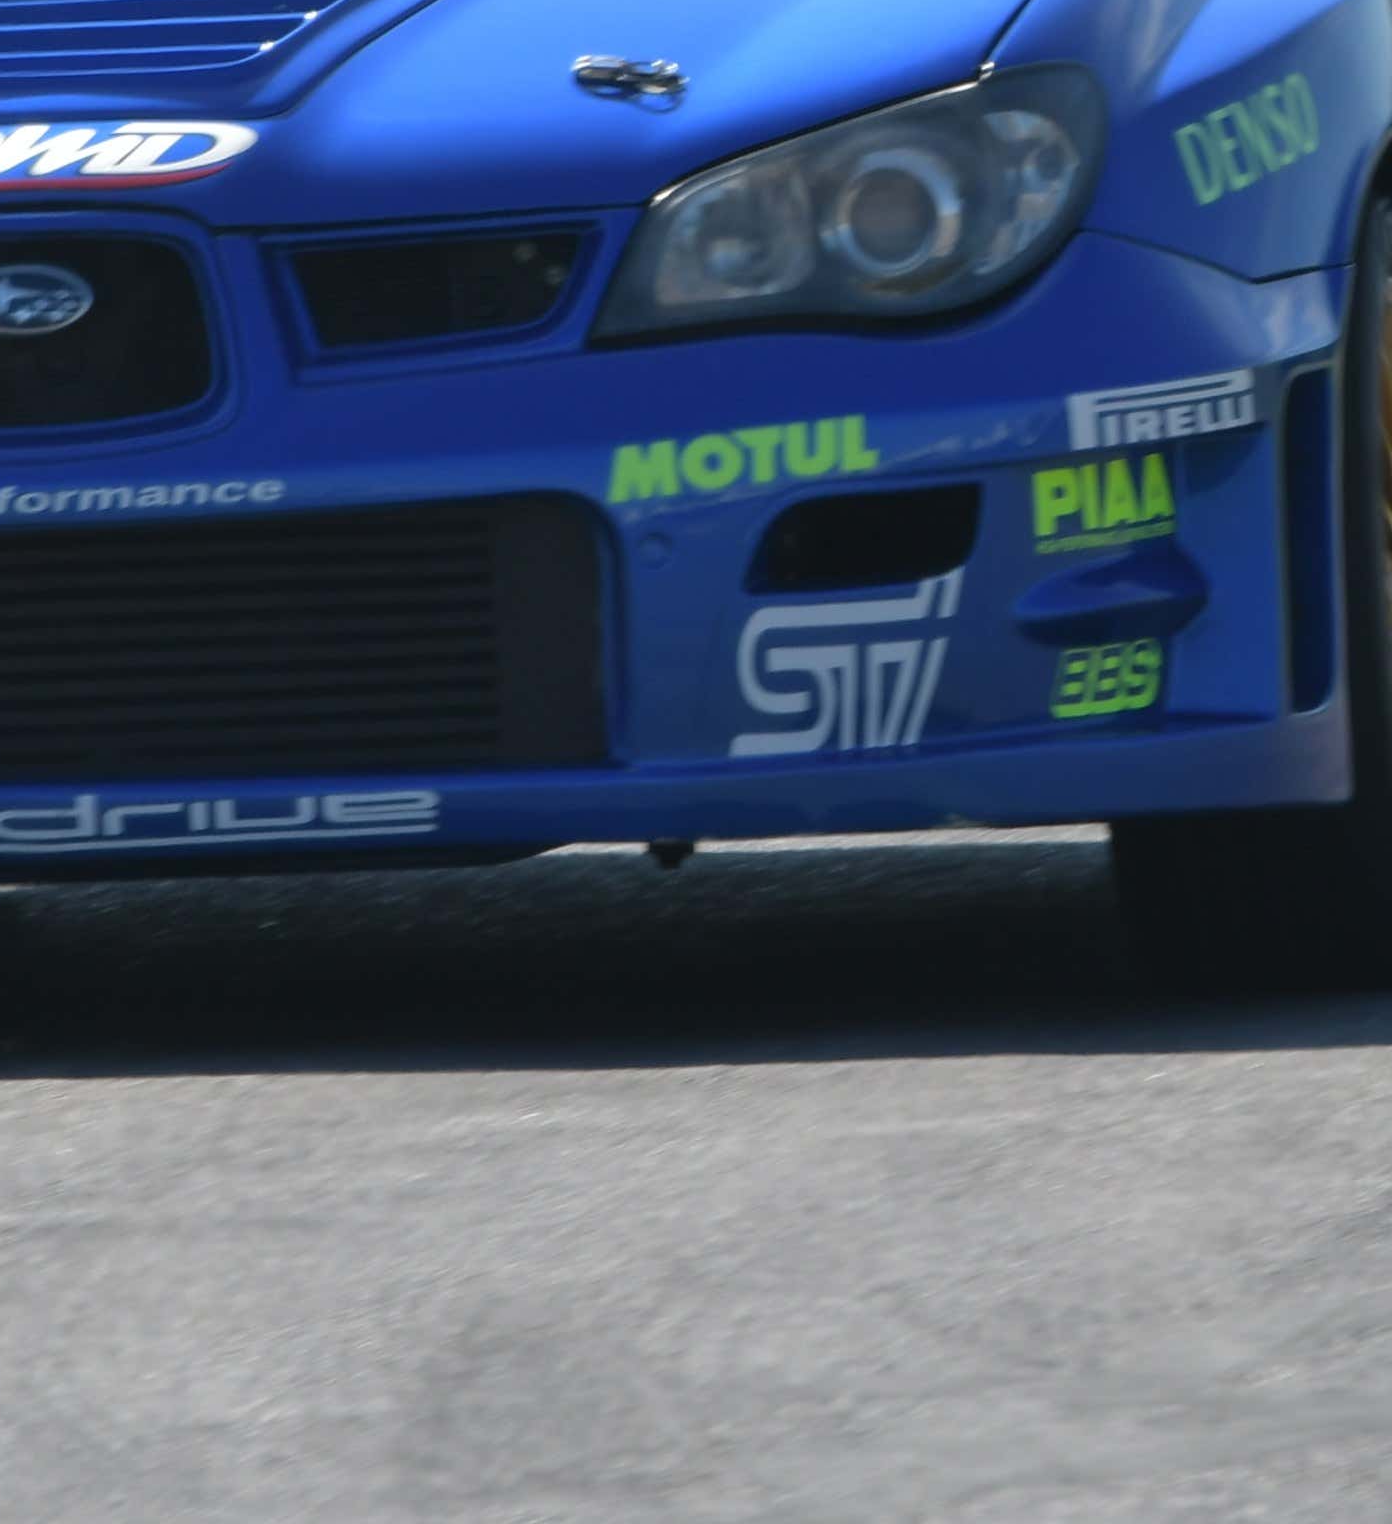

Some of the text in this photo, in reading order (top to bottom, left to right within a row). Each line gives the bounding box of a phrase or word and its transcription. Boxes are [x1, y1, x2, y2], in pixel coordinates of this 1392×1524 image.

[1173, 71, 1321, 206] DENSO
[1067, 368, 1256, 452] PIRELLI
[608, 414, 880, 504] MOTUL
[1032, 452, 1177, 538] PIAA
